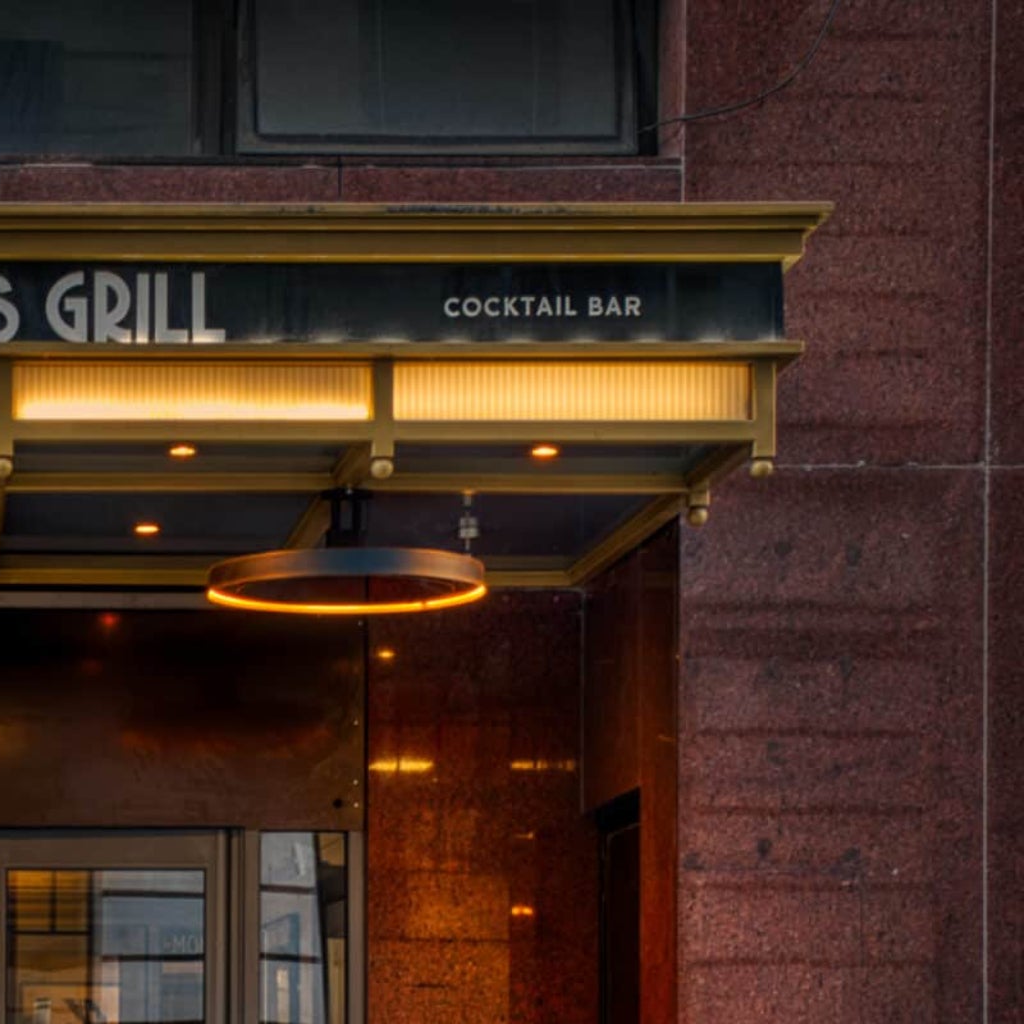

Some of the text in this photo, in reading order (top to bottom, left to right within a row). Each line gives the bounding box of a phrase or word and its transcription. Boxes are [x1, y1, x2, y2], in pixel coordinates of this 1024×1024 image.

[45, 270, 226, 344] GRILL
[443, 296, 642, 318] COCKTAIL BAR
